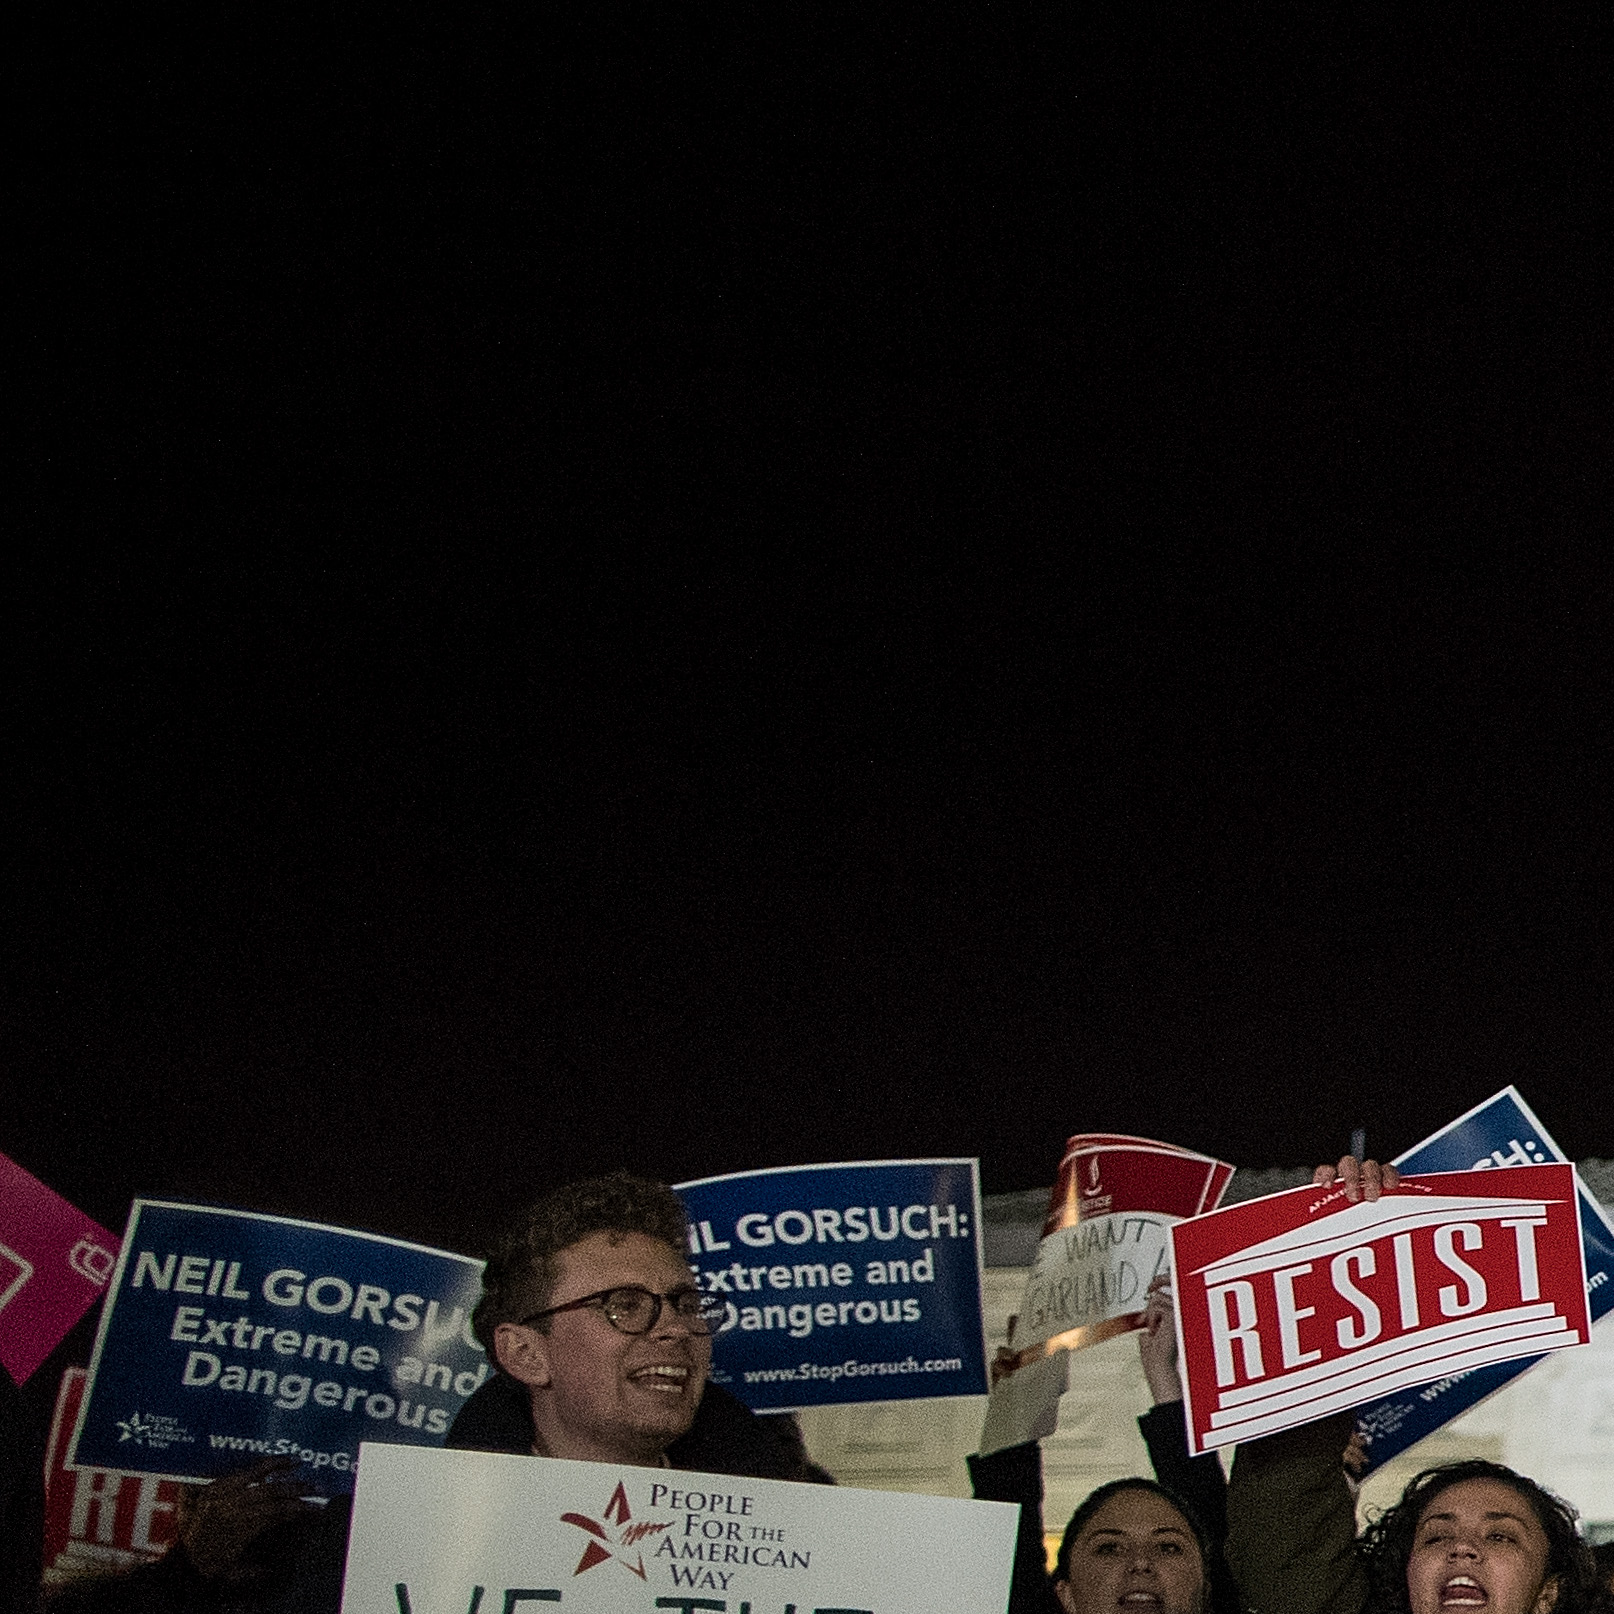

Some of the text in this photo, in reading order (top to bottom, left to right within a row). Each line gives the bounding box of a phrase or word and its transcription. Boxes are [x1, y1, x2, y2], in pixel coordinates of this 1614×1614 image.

[687, 1204, 969, 1255] IL GORSUCH:
[132, 1250, 251, 1301] NEIL
[866, 1248, 934, 1285] and
[1205, 1216, 1549, 1388] RESIST
[171, 1306, 490, 1398] Extreme and
[743, 1355, 962, 1383] www.StopGorsuch.com
[181, 1350, 450, 1436] Dangerous
[650, 1483, 755, 1517] PEOPLE
[684, 1513, 786, 1543] FOR THE
[653, 1534, 812, 1570] AMERICAN
[670, 1563, 735, 1592] WAY
